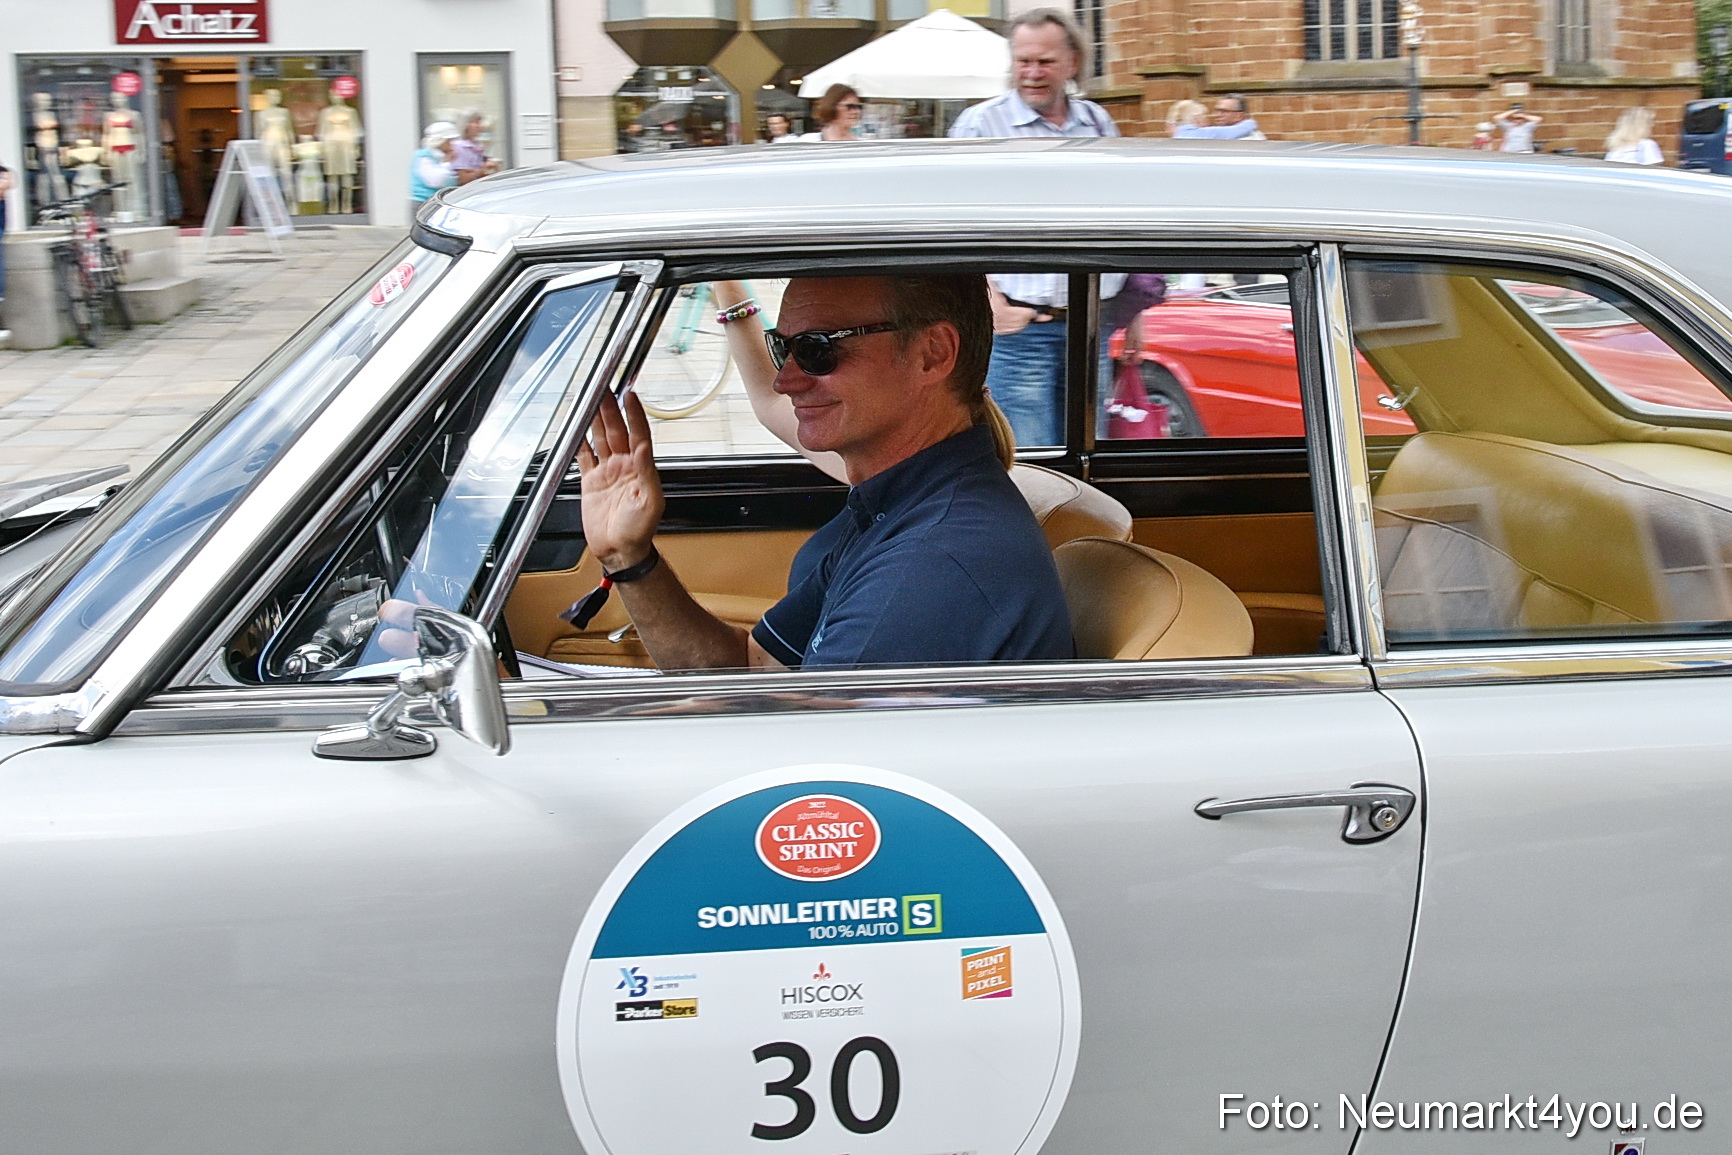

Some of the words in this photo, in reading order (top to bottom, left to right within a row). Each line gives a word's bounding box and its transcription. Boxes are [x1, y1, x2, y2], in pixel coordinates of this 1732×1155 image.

[124, 0, 260, 39] Achatz
[771, 821, 865, 842] CLASSIC
[779, 841, 858, 861] SPRINT
[697, 897, 898, 929] SONNLEITNER
[855, 922, 899, 937] AUTO
[966, 952, 1006, 971] PRINT
[977, 965, 997, 978] and
[781, 983, 863, 1005] HISCOX
[967, 975, 1007, 993] PIXEL
[750, 1036, 901, 1141] 30
